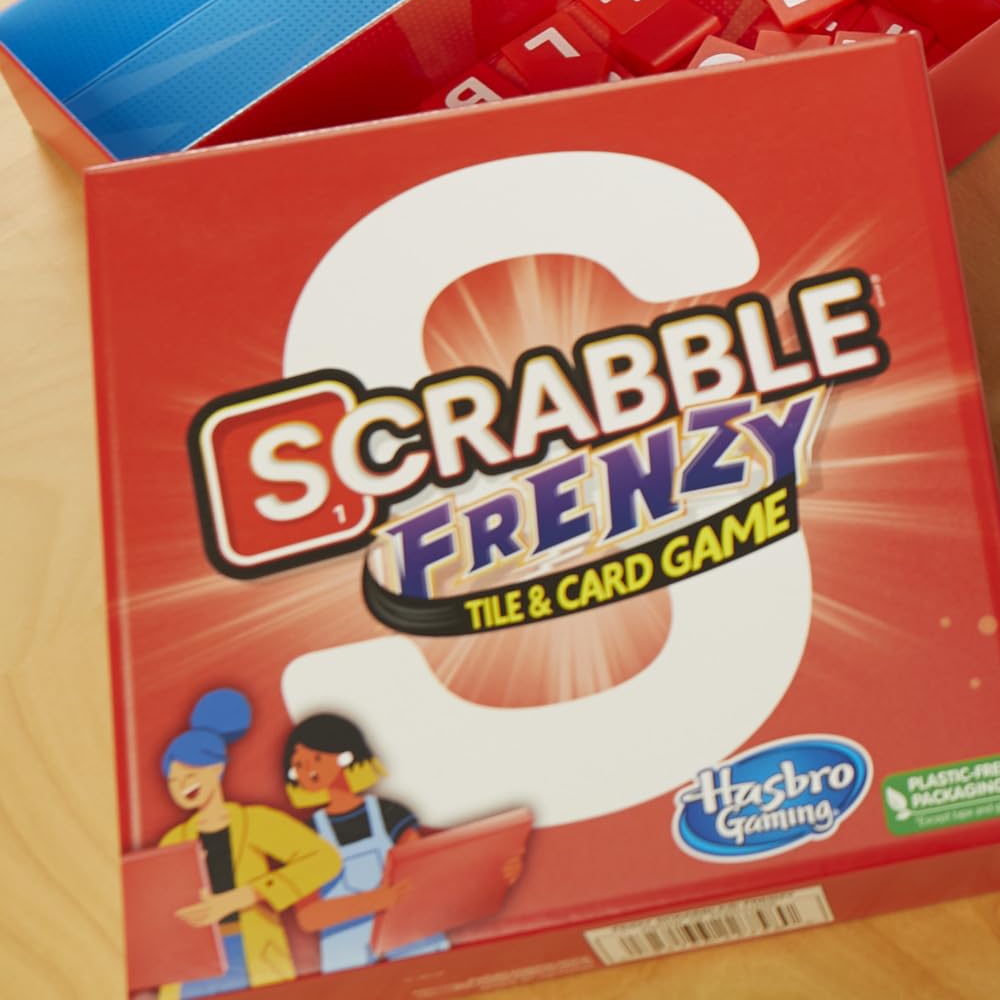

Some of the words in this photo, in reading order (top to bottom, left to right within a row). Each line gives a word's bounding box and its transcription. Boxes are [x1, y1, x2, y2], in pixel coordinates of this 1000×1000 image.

[524, 27, 580, 58] L
[247, 279, 881, 523] SCRABBLE
[387, 396, 824, 599] FRENZY
[464, 588, 525, 631] TILE
[528, 585, 552, 619] &
[556, 553, 654, 611] CARD
[660, 488, 791, 578] GAME
[681, 760, 854, 814] Hasbro
[716, 799, 834, 845] Gaming
